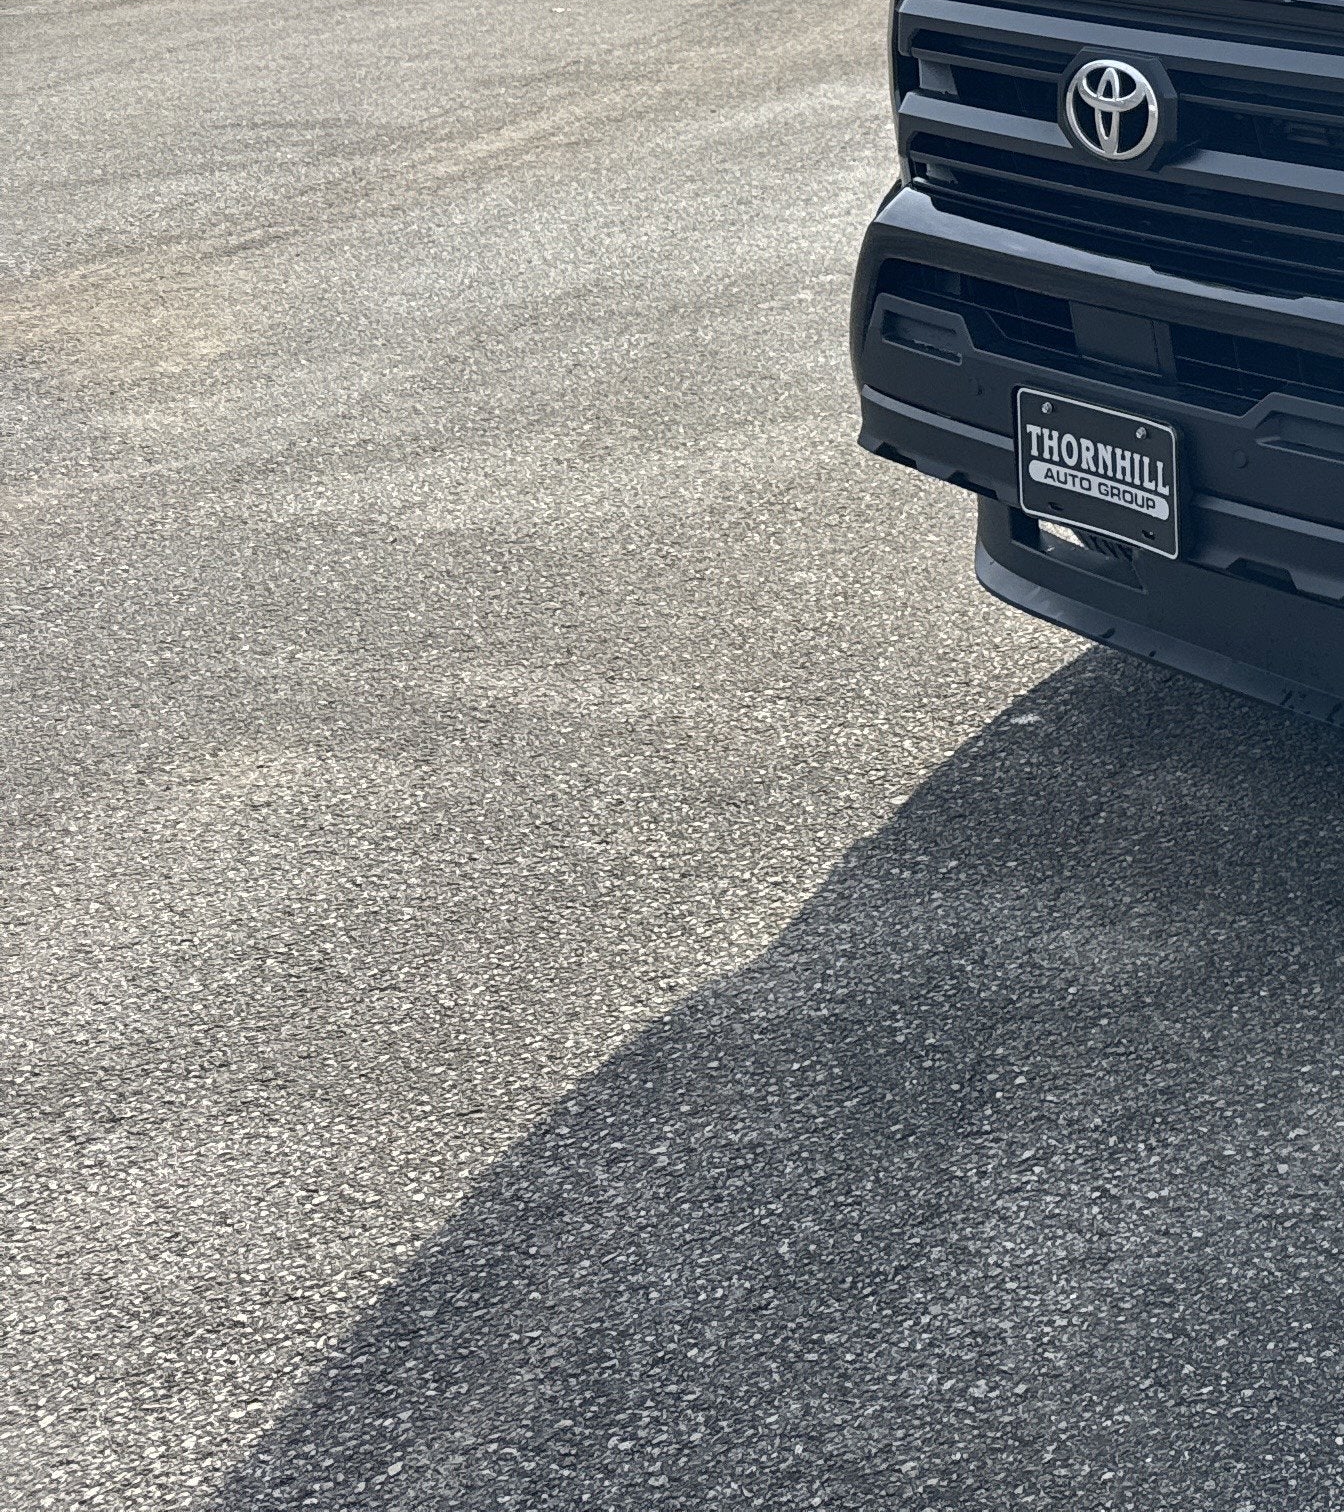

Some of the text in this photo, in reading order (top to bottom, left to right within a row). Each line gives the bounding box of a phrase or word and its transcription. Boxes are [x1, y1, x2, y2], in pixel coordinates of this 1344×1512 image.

[1026, 424, 1169, 495] THORNHILL
[1044, 467, 1156, 512] AUTO GROUP
